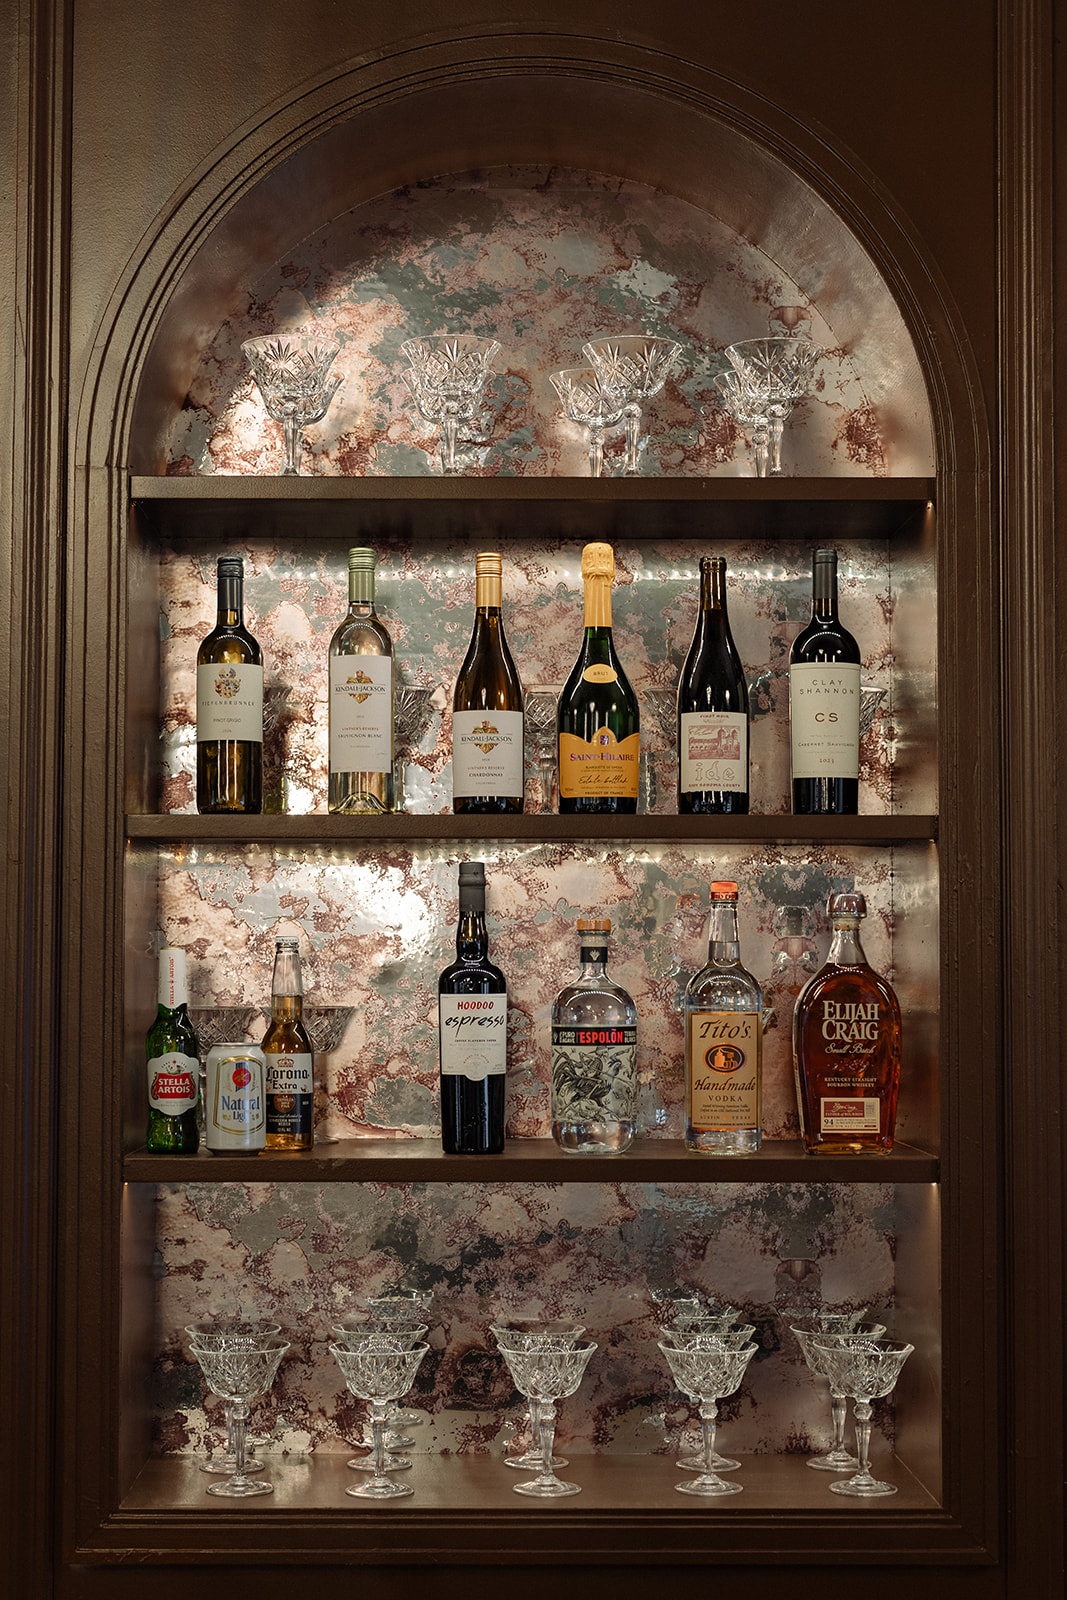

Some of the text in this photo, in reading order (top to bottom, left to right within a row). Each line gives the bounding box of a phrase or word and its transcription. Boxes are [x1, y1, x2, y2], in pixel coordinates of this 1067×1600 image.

[335, 685, 386, 693] KENDALL-JACKSON
[570, 752, 635, 762] SAINT-HILAIRE
[457, 1001, 494, 1010] HOODOO
[822, 1000, 880, 1023] ELIJAH
[445, 1015, 505, 1038] espresso
[821, 1019, 879, 1043] CRAIG
[158, 1078, 190, 1086] STELLA
[271, 1080, 298, 1090] Extra
[694, 1076, 756, 1091] Handmade
[158, 1086, 190, 1094] ARTOIS
[221, 1095, 260, 1111] Natural
